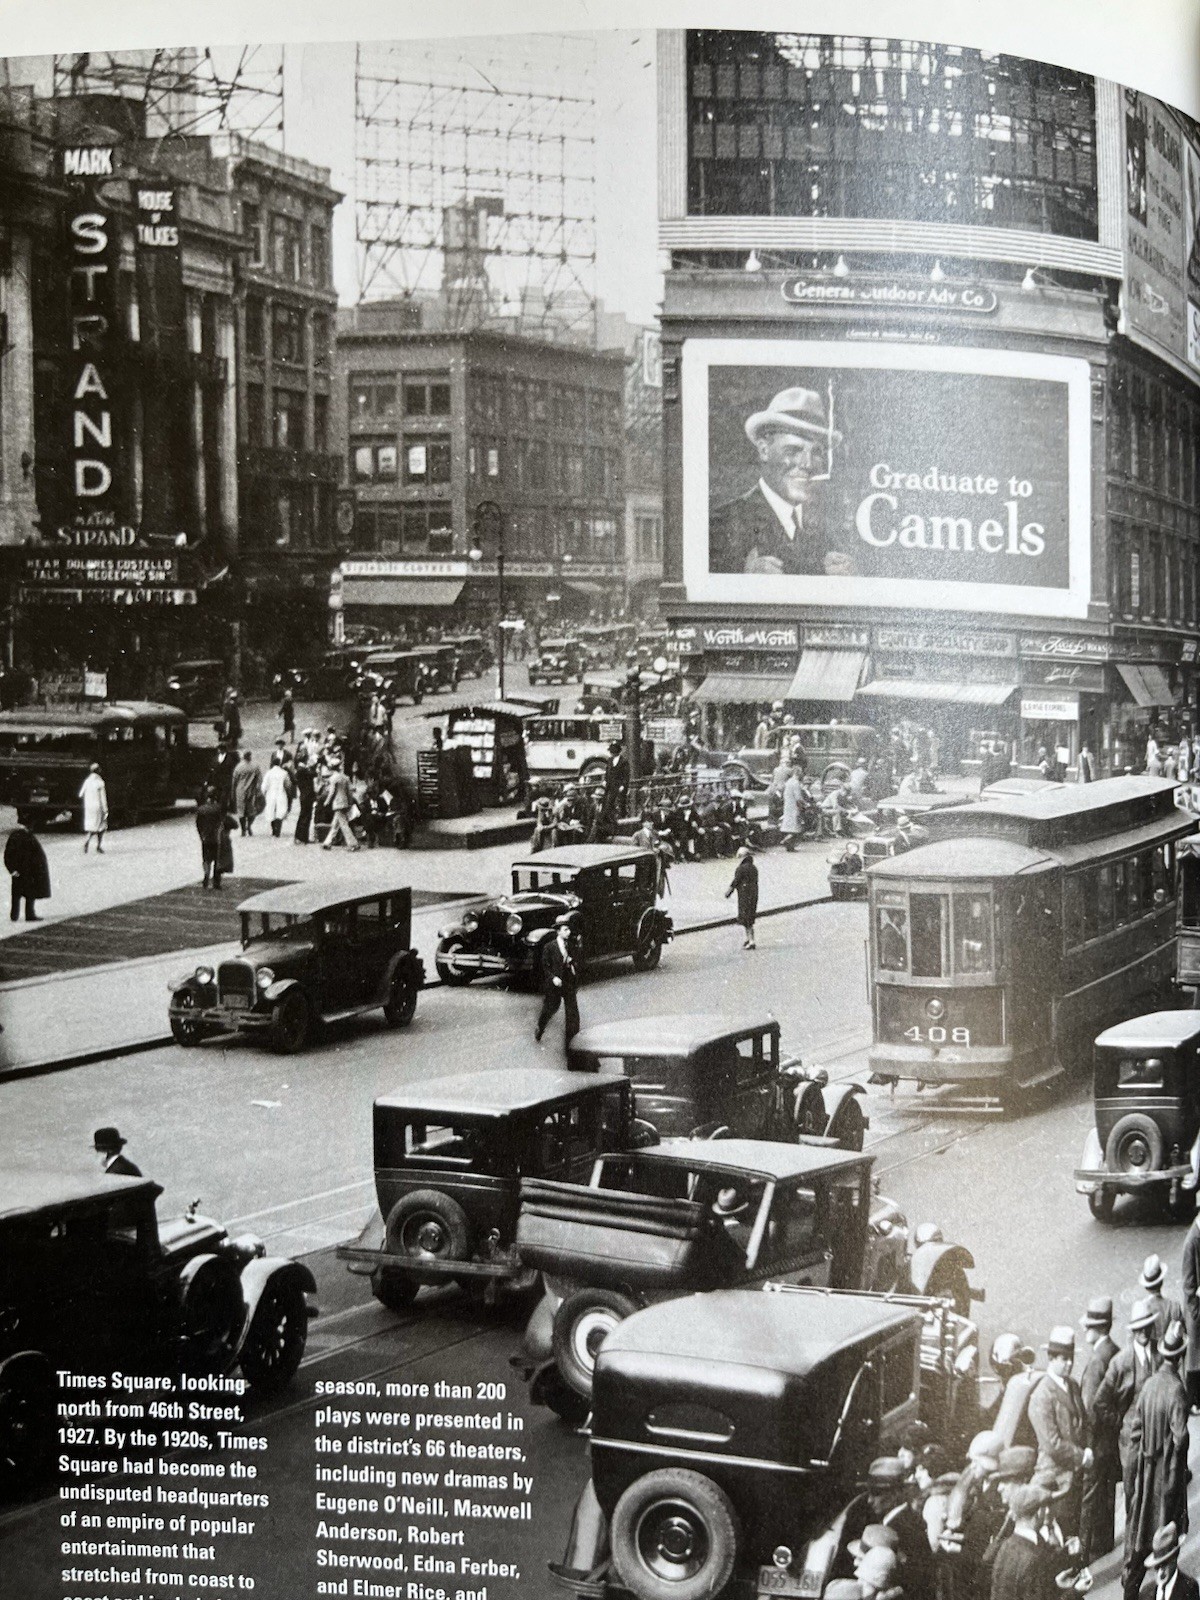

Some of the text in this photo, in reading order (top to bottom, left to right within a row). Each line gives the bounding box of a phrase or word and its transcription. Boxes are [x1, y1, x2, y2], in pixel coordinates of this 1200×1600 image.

[64, 148, 113, 175] MARK
[927, 287, 957, 304] Adv
[961, 289, 984, 307] Co
[70, 213, 114, 497] STRAND
[869, 463, 1033, 498] Graduate to
[856, 492, 1045, 556] Camels
[58, 526, 136, 546] STRAND
[116, 559, 172, 570] COSTELLO
[87, 570, 147, 581] REDEEMING
[703, 628, 744, 645] Worth
[754, 629, 797, 646] Worth
